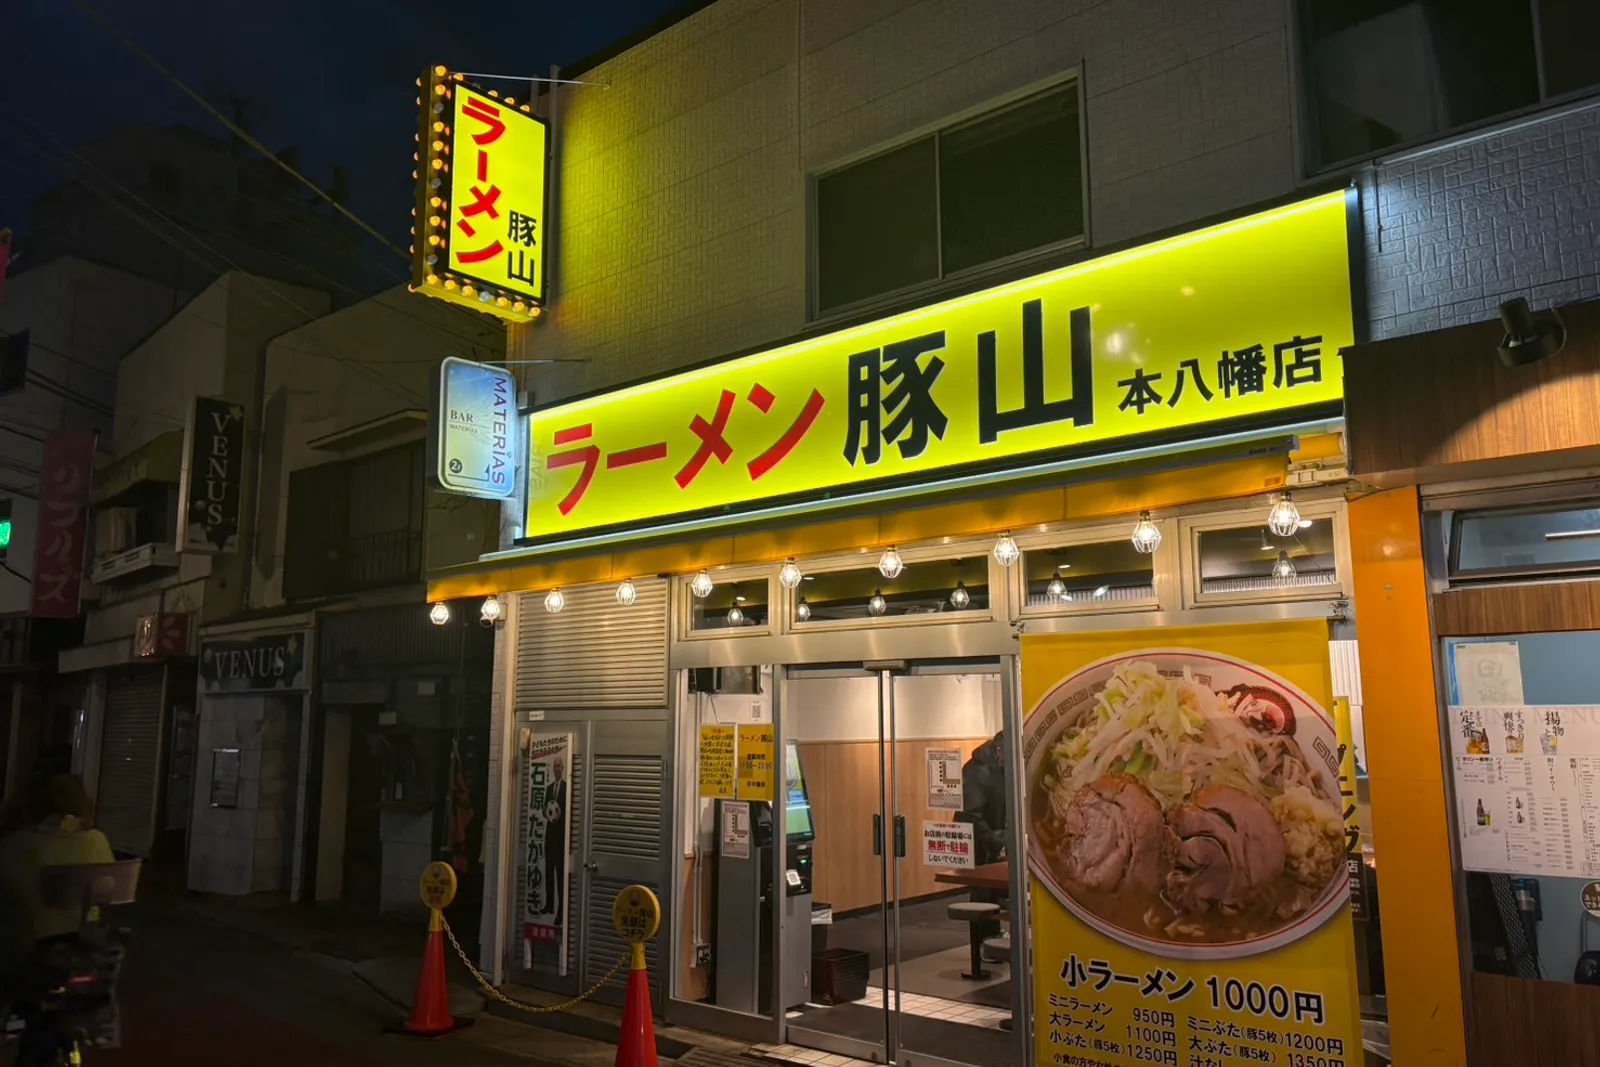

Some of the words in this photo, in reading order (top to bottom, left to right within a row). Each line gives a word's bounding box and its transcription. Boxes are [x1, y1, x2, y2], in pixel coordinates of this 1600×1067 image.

[456, 96, 506, 264] ラーメン
[508, 210, 537, 287] 豚山
[450, 409, 474, 424] BAR
[547, 382, 826, 516] ラーメン
[843, 298, 1094, 468] 豚山
[1117, 335, 1323, 415] 本八幡店
[205, 412, 230, 525] VENUS
[215, 646, 285, 679] VENUS
[526, 763, 546, 915] 石原たかゆき
[1049, 993, 1113, 1016] ミニラーメン
[1132, 1007, 1175, 1028] 950円
[1061, 955, 1195, 1002] 小ラーメン
[1207, 976, 1324, 1025] 1000円
[1049, 1011, 1106, 1032] 大ラーメン
[1126, 1024, 1177, 1047] 1100円
[1126, 1043, 1178, 1067] 1250円
[1285, 1032, 1344, 1056] 1200円
